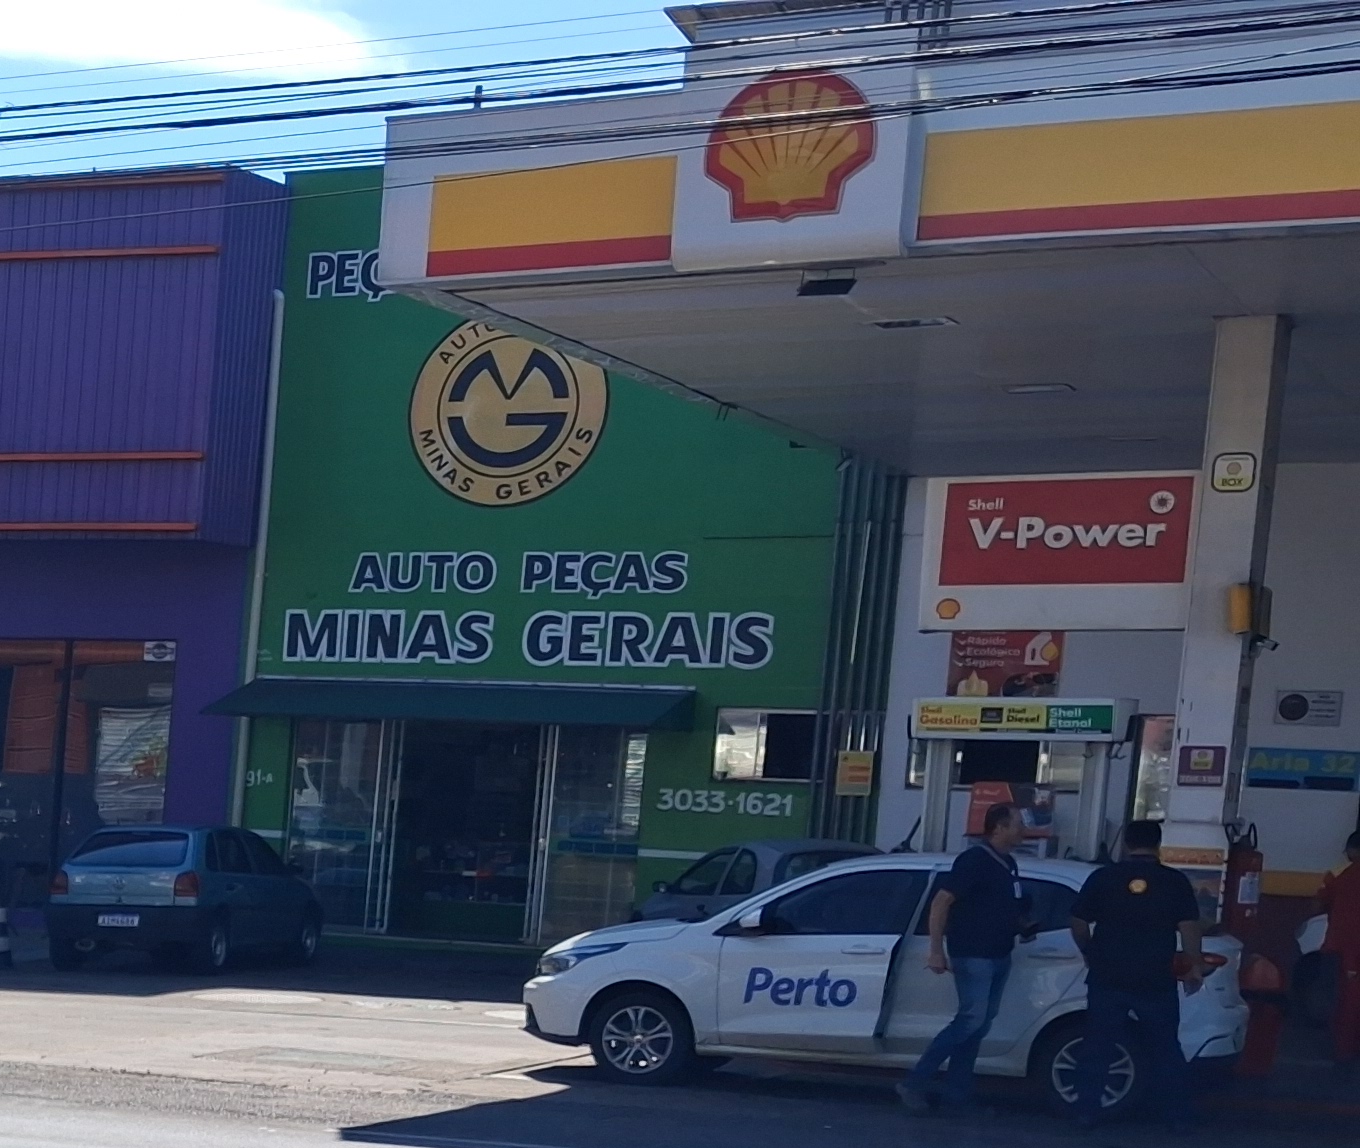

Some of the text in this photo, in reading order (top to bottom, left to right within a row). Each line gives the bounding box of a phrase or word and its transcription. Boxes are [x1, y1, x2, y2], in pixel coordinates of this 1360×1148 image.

[307, 250, 390, 301] PEÇ
[419, 427, 593, 500] MINAS GERAIS
[968, 498, 1004, 511] Shell
[968, 516, 1166, 549] V-Power
[349, 552, 689, 600] AUTO PEÇAS
[283, 610, 775, 669] MINAS GERAIS
[919, 714, 978, 726] Gasolina
[1006, 714, 1040, 724] Diesel
[1048, 707, 1081, 718] Shell
[1048, 718, 1092, 728] Etanol
[1321, 754, 1357, 773] 32
[743, 967, 857, 1007] Perto
